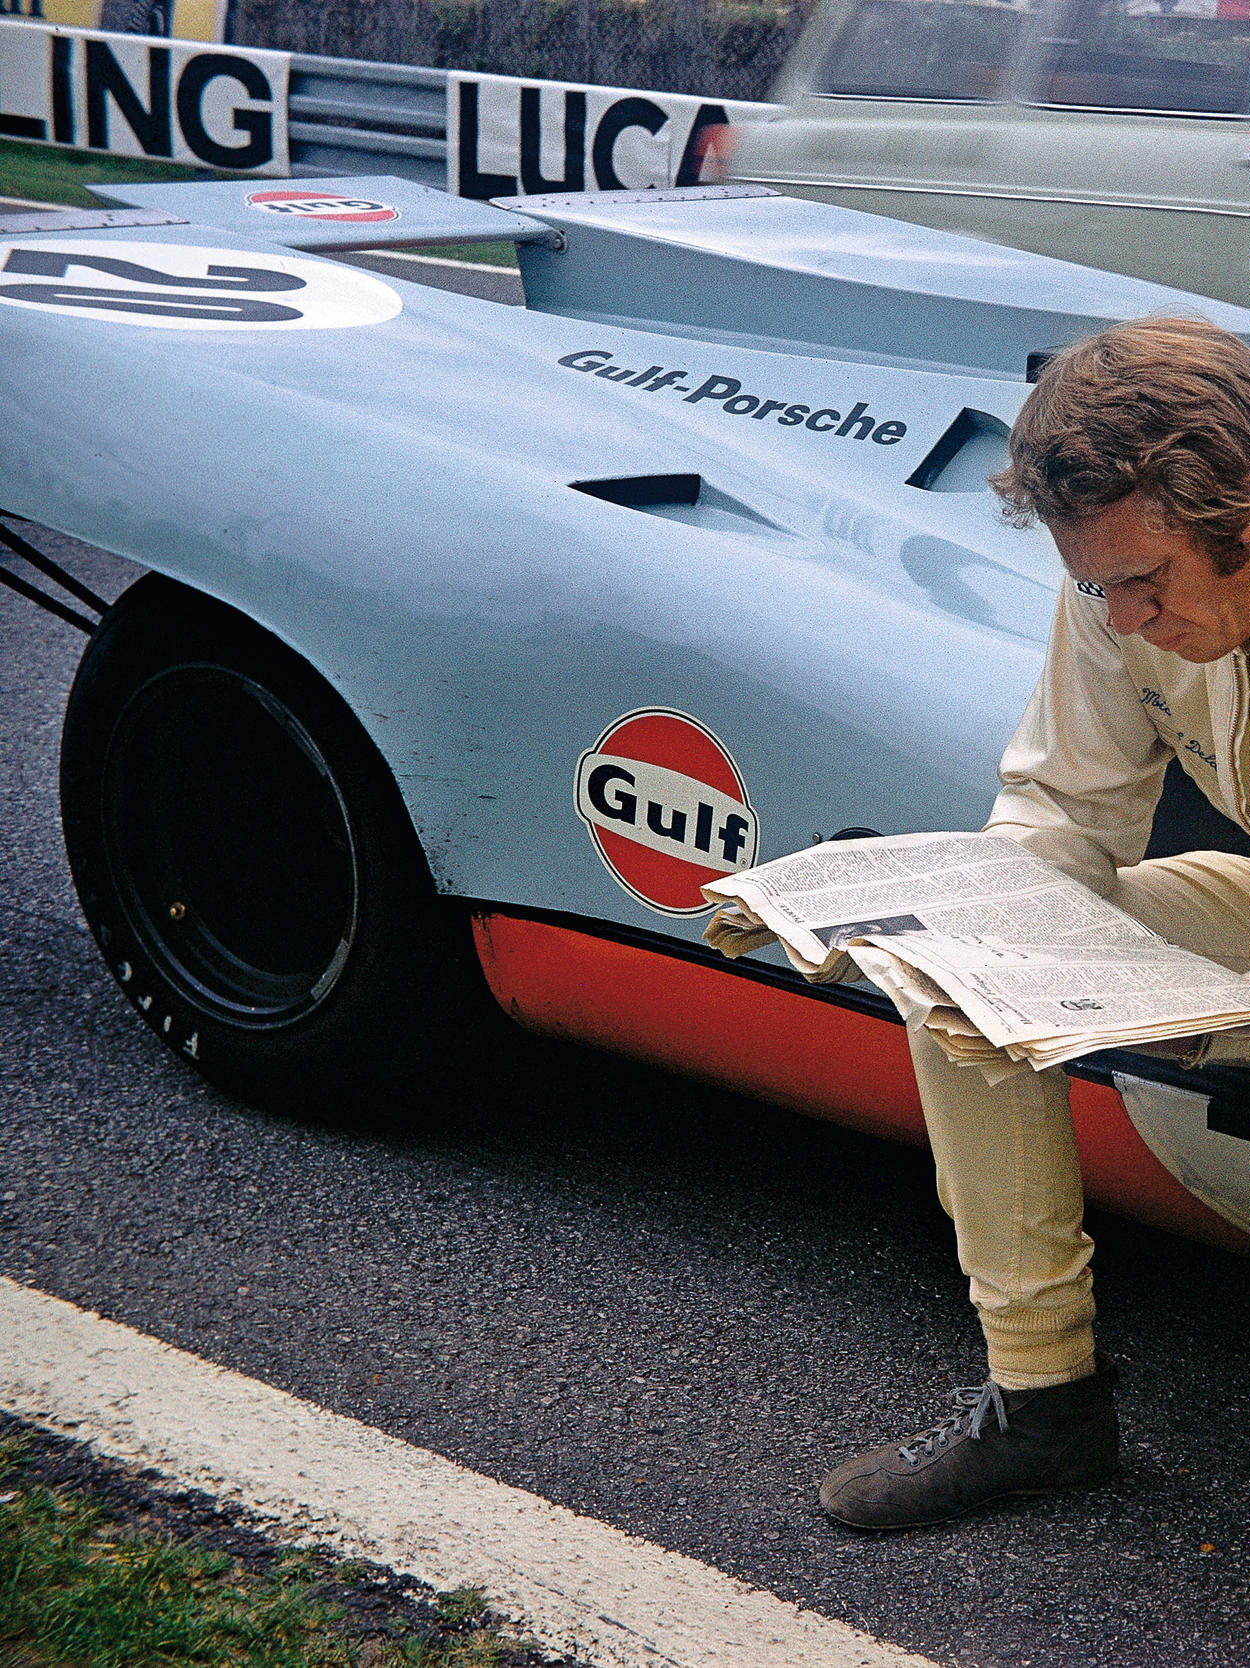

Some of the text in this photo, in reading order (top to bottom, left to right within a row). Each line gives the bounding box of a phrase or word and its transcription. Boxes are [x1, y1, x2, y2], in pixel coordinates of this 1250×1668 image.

[0, 248, 307, 322] 20
[557, 350, 908, 446] Gulf-Porsche
[587, 763, 750, 865] Gulf
